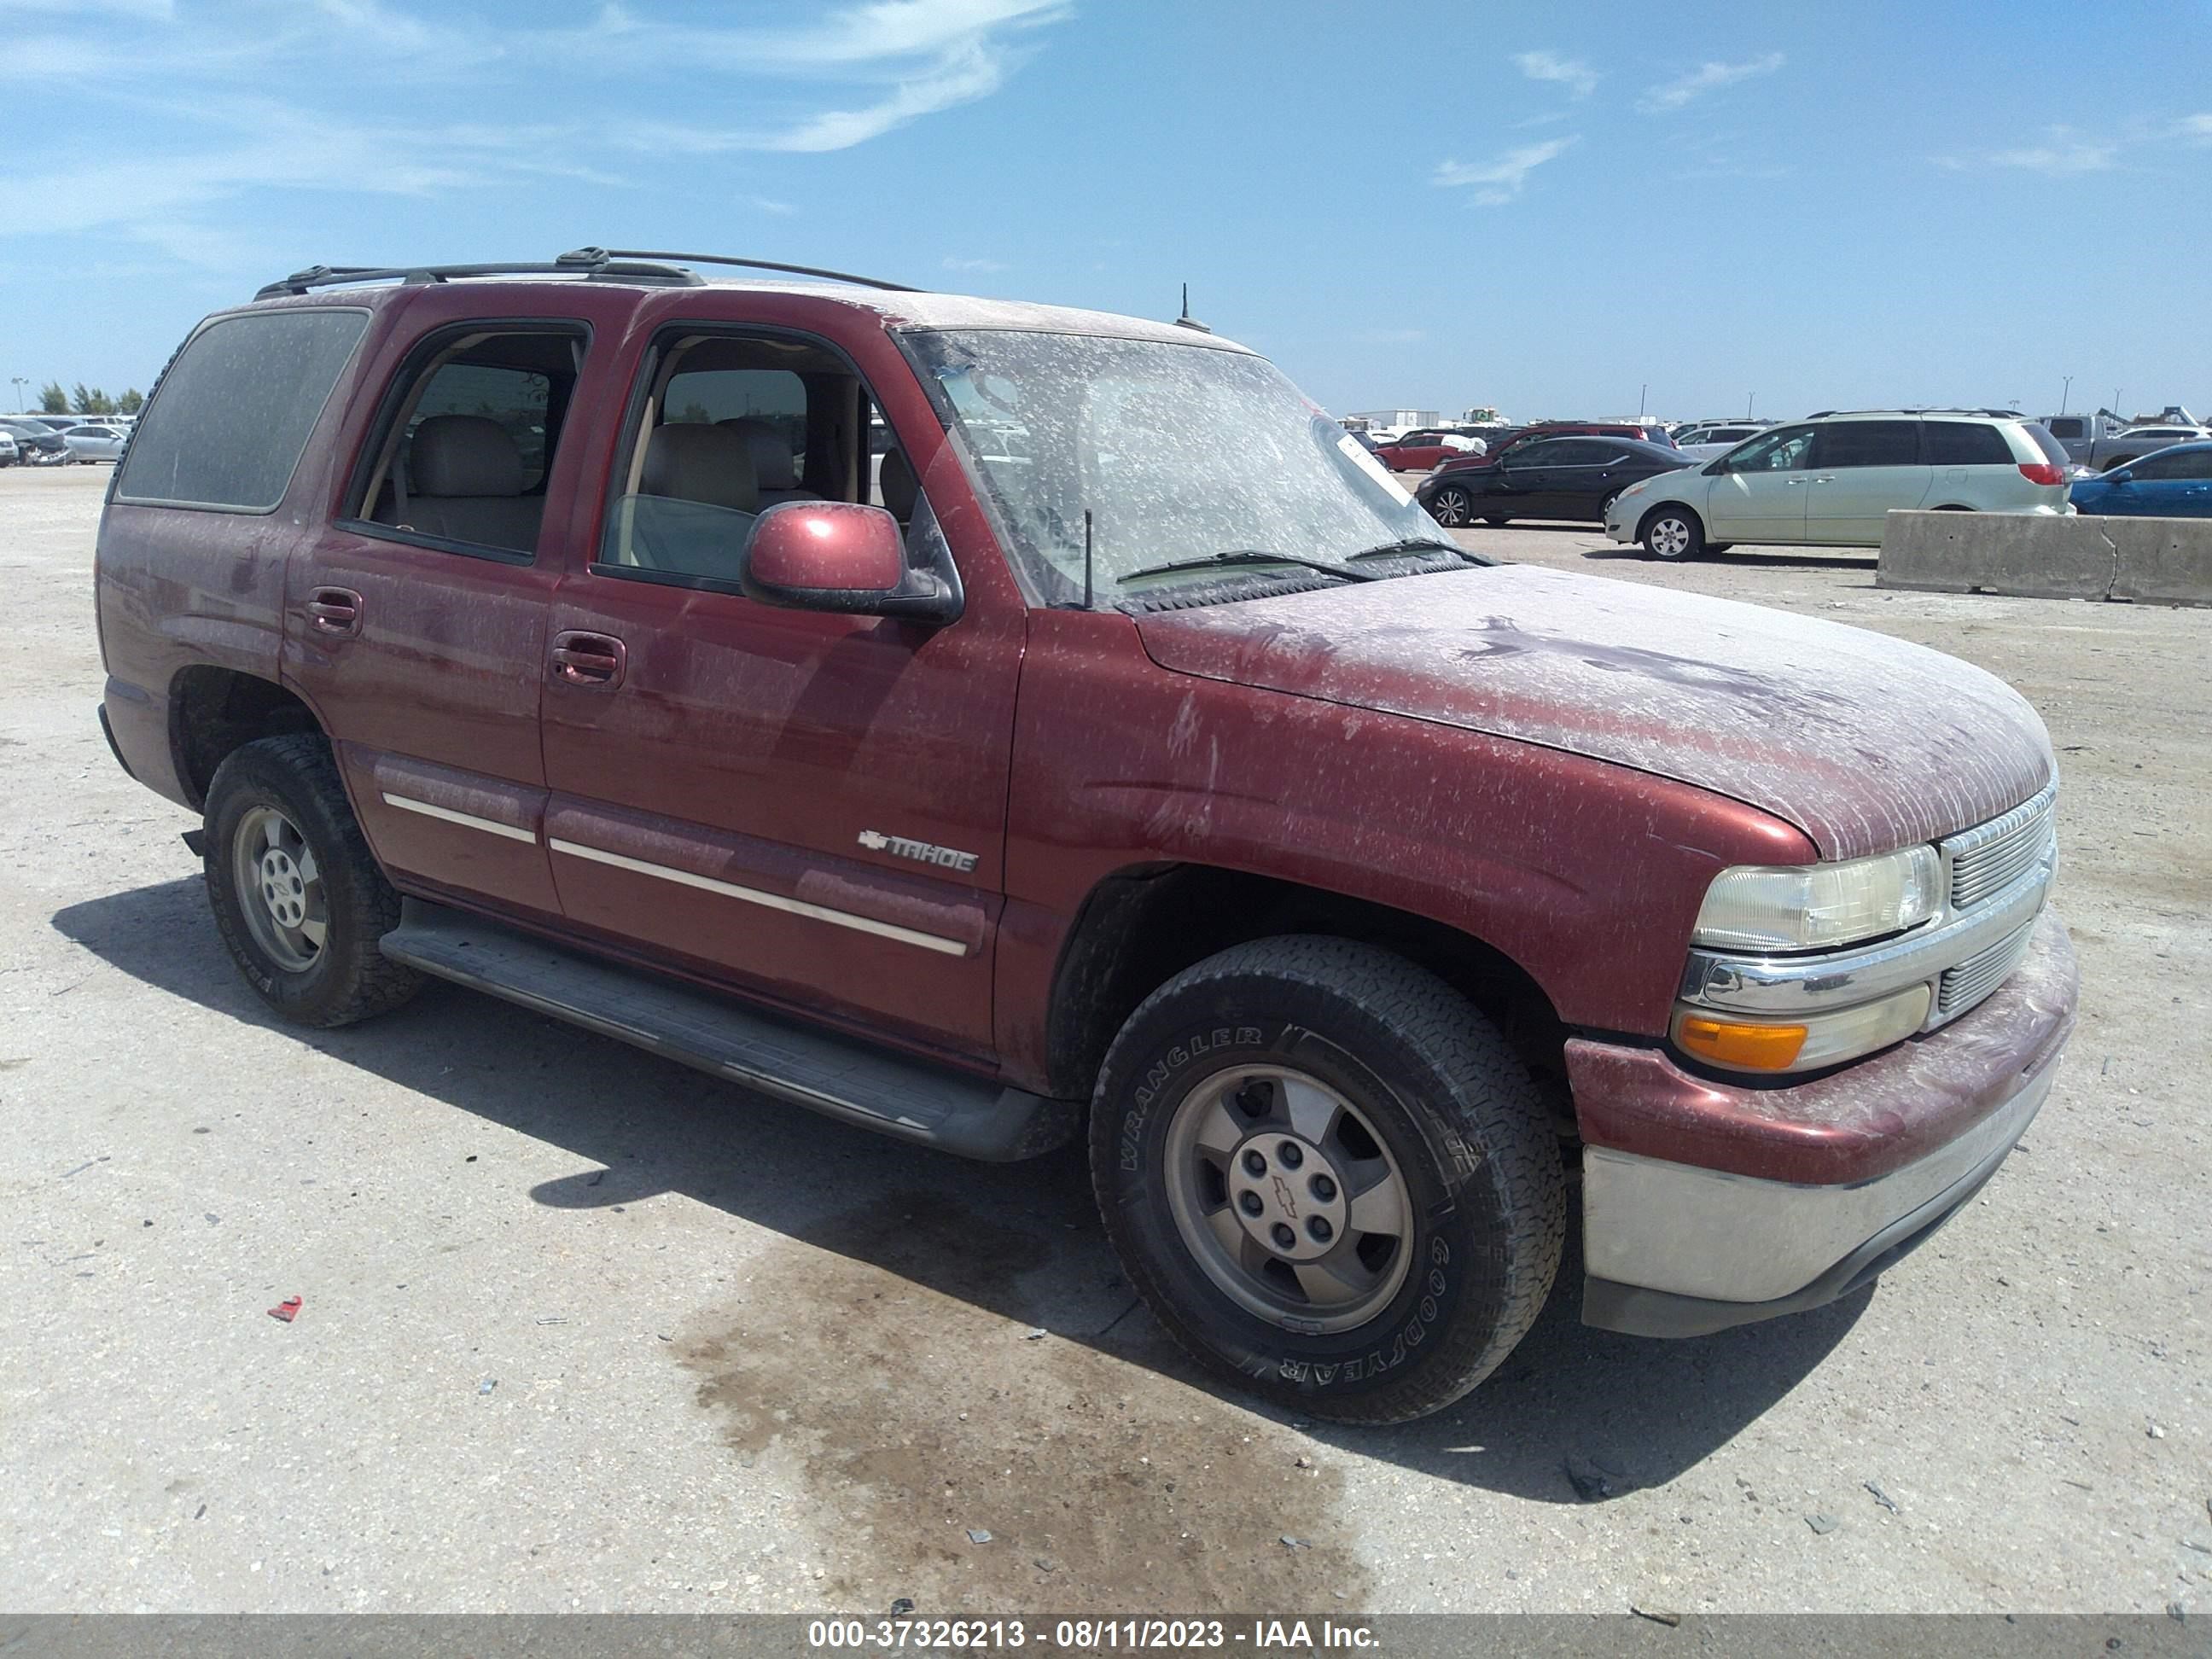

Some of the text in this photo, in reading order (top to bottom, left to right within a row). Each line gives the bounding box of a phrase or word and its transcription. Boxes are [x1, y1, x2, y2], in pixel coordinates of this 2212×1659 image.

[888, 835, 979, 872] TAHOE
[1120, 1027, 1264, 1172] WRANGLER
[1278, 1235, 1450, 1386] GOODYEAR
